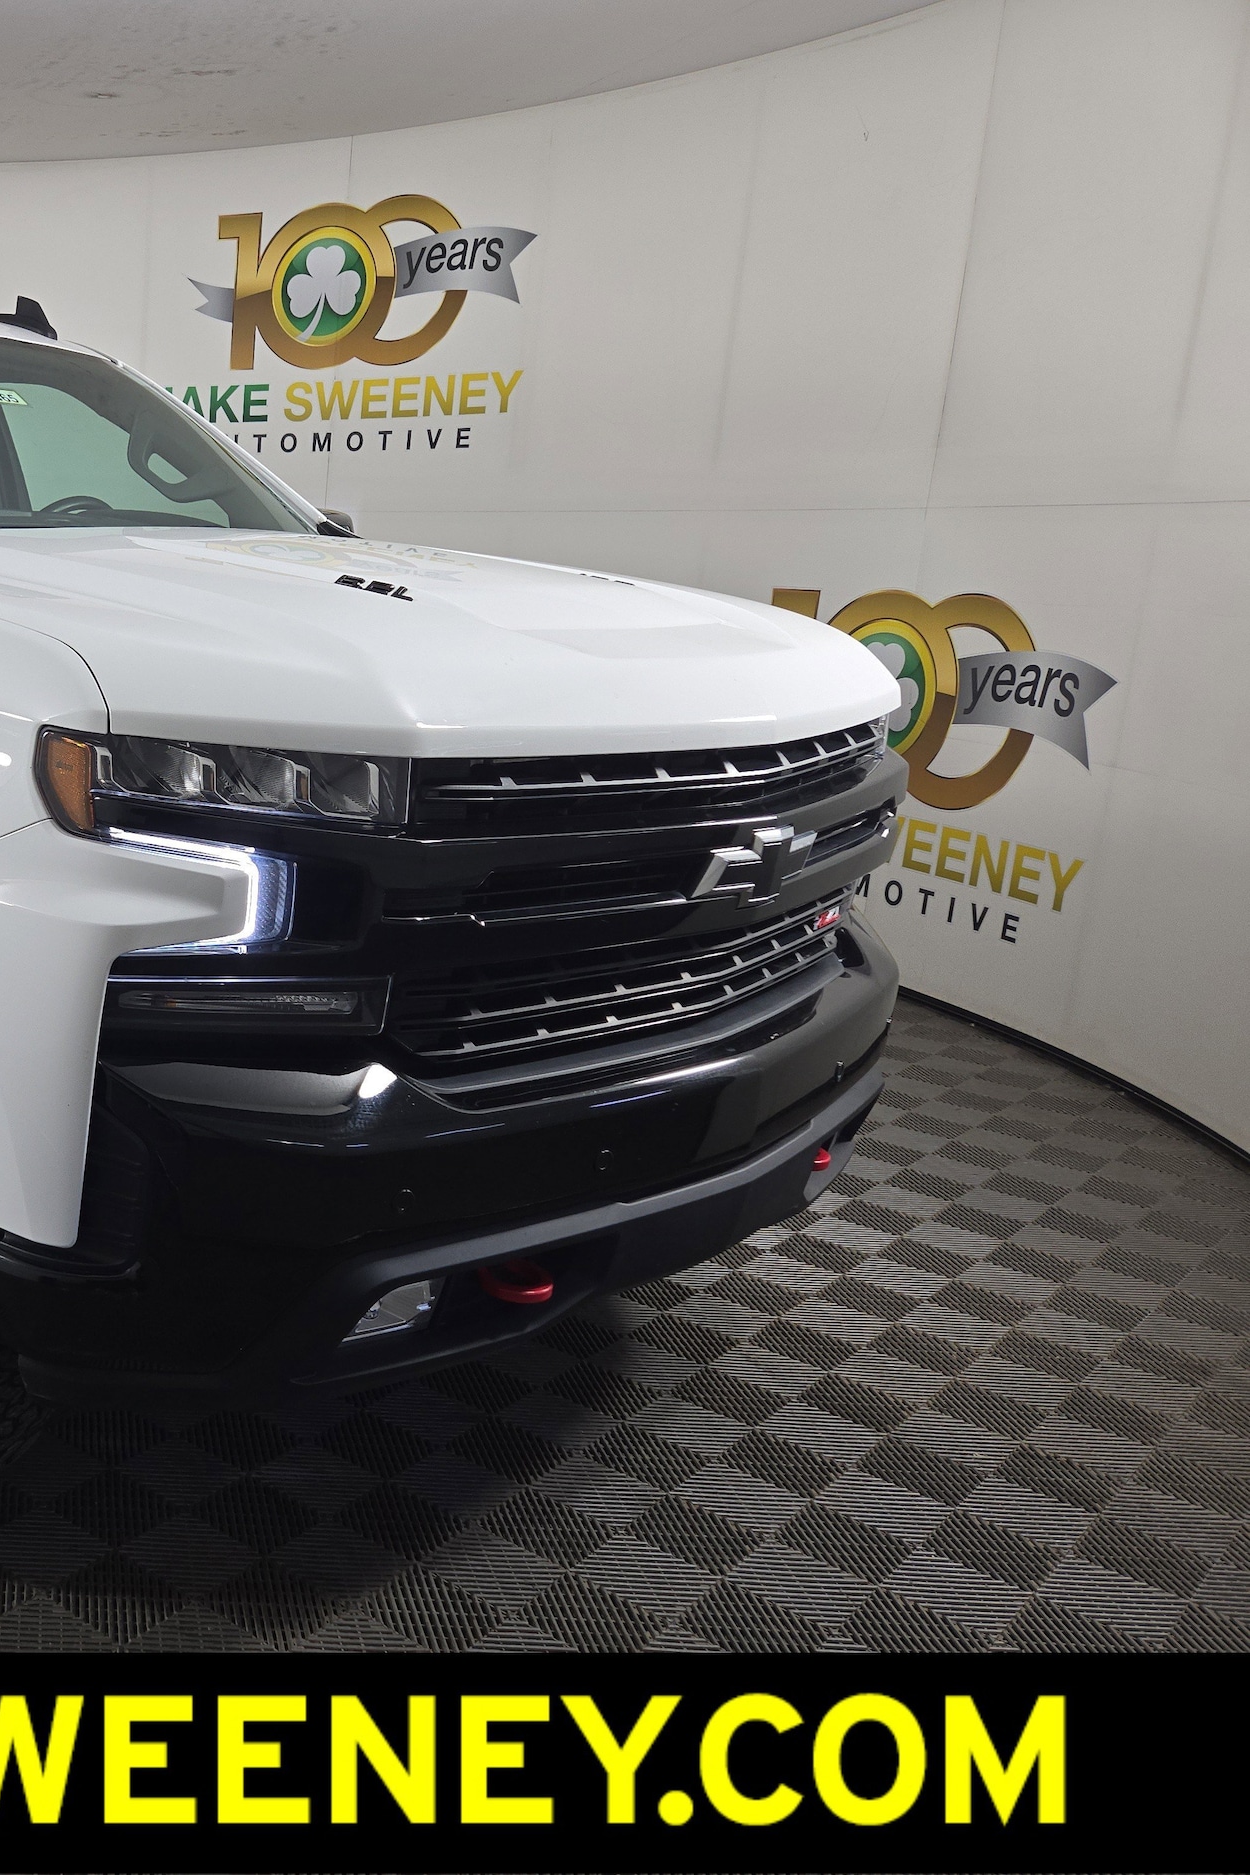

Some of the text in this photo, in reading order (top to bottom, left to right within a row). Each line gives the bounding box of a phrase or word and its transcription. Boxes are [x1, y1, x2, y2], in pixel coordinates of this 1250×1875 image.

[218, 194, 504, 371] 100 years
[166, 370, 524, 423] AKE SWEENEY
[234, 427, 471, 454] TOMOTIVE
[963, 663, 1081, 718] years
[886, 816, 1085, 913] EENEY
[855, 873, 1020, 944] MOTIVE
